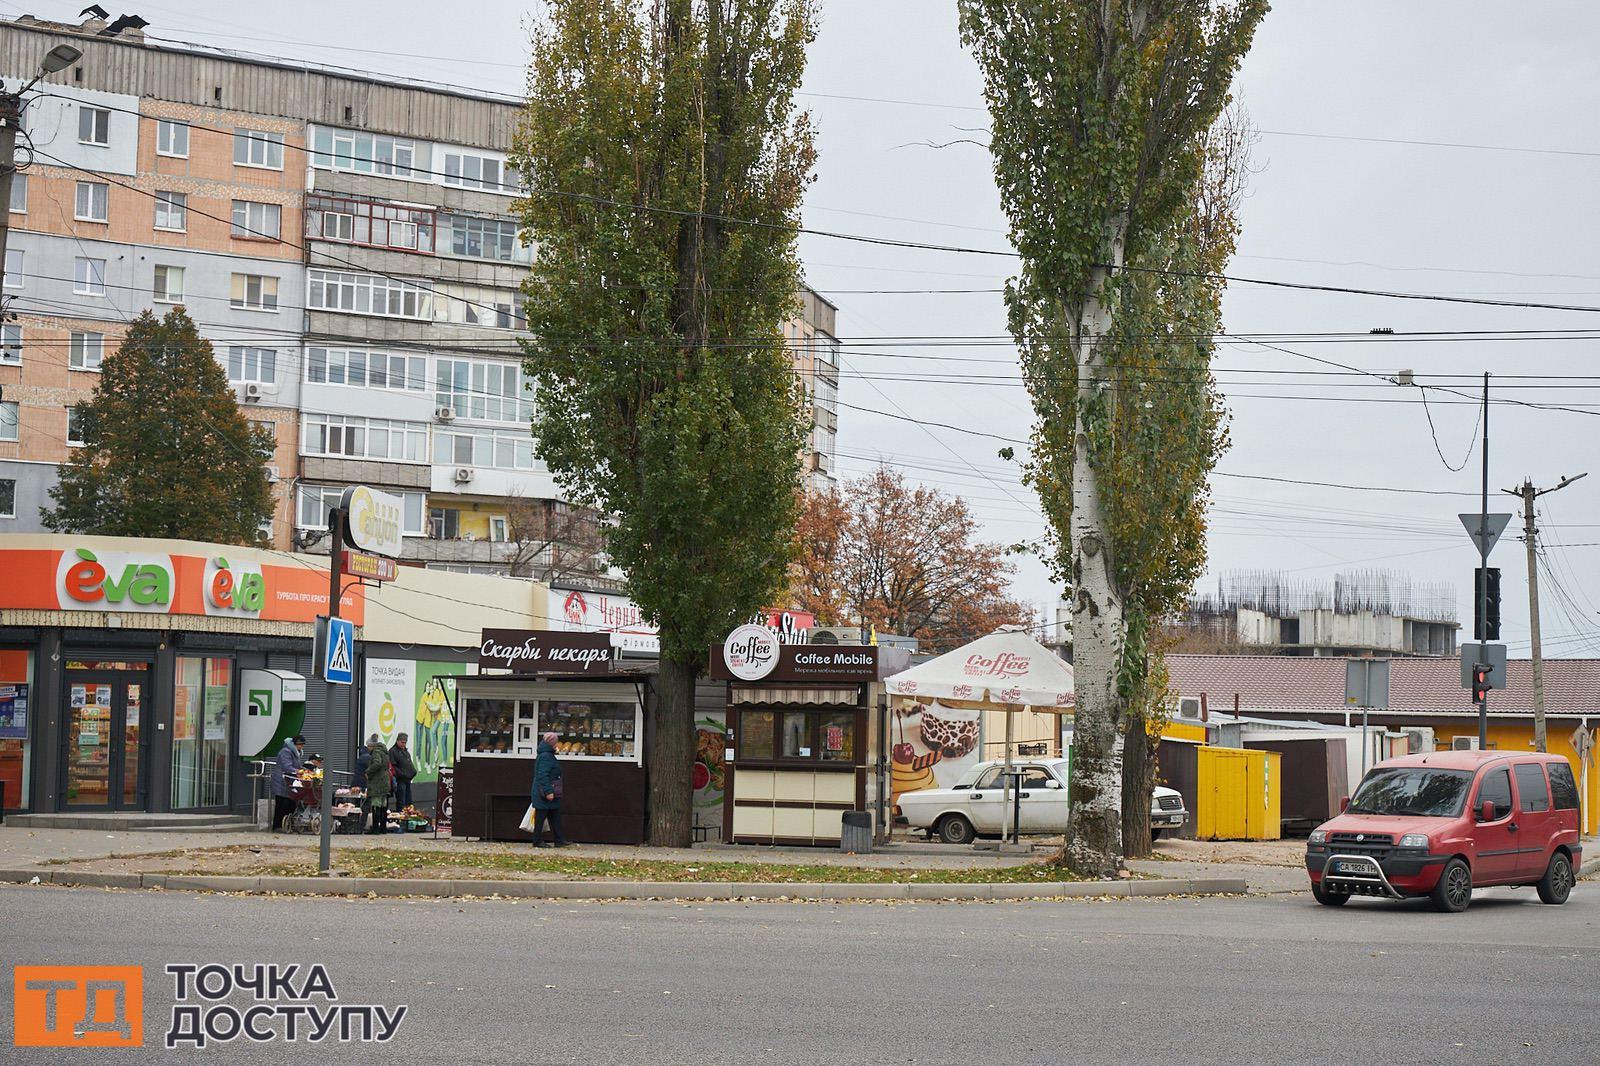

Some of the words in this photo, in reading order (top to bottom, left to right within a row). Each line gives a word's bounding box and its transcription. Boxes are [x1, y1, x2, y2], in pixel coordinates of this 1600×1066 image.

[480, 636, 542, 667] Скарби
[547, 648, 610, 670] пекаря
[730, 636, 771, 664] Coffee
[795, 653, 831, 664] Coffee
[833, 653, 873, 665] Mobile
[966, 652, 1029, 677] Coffee
